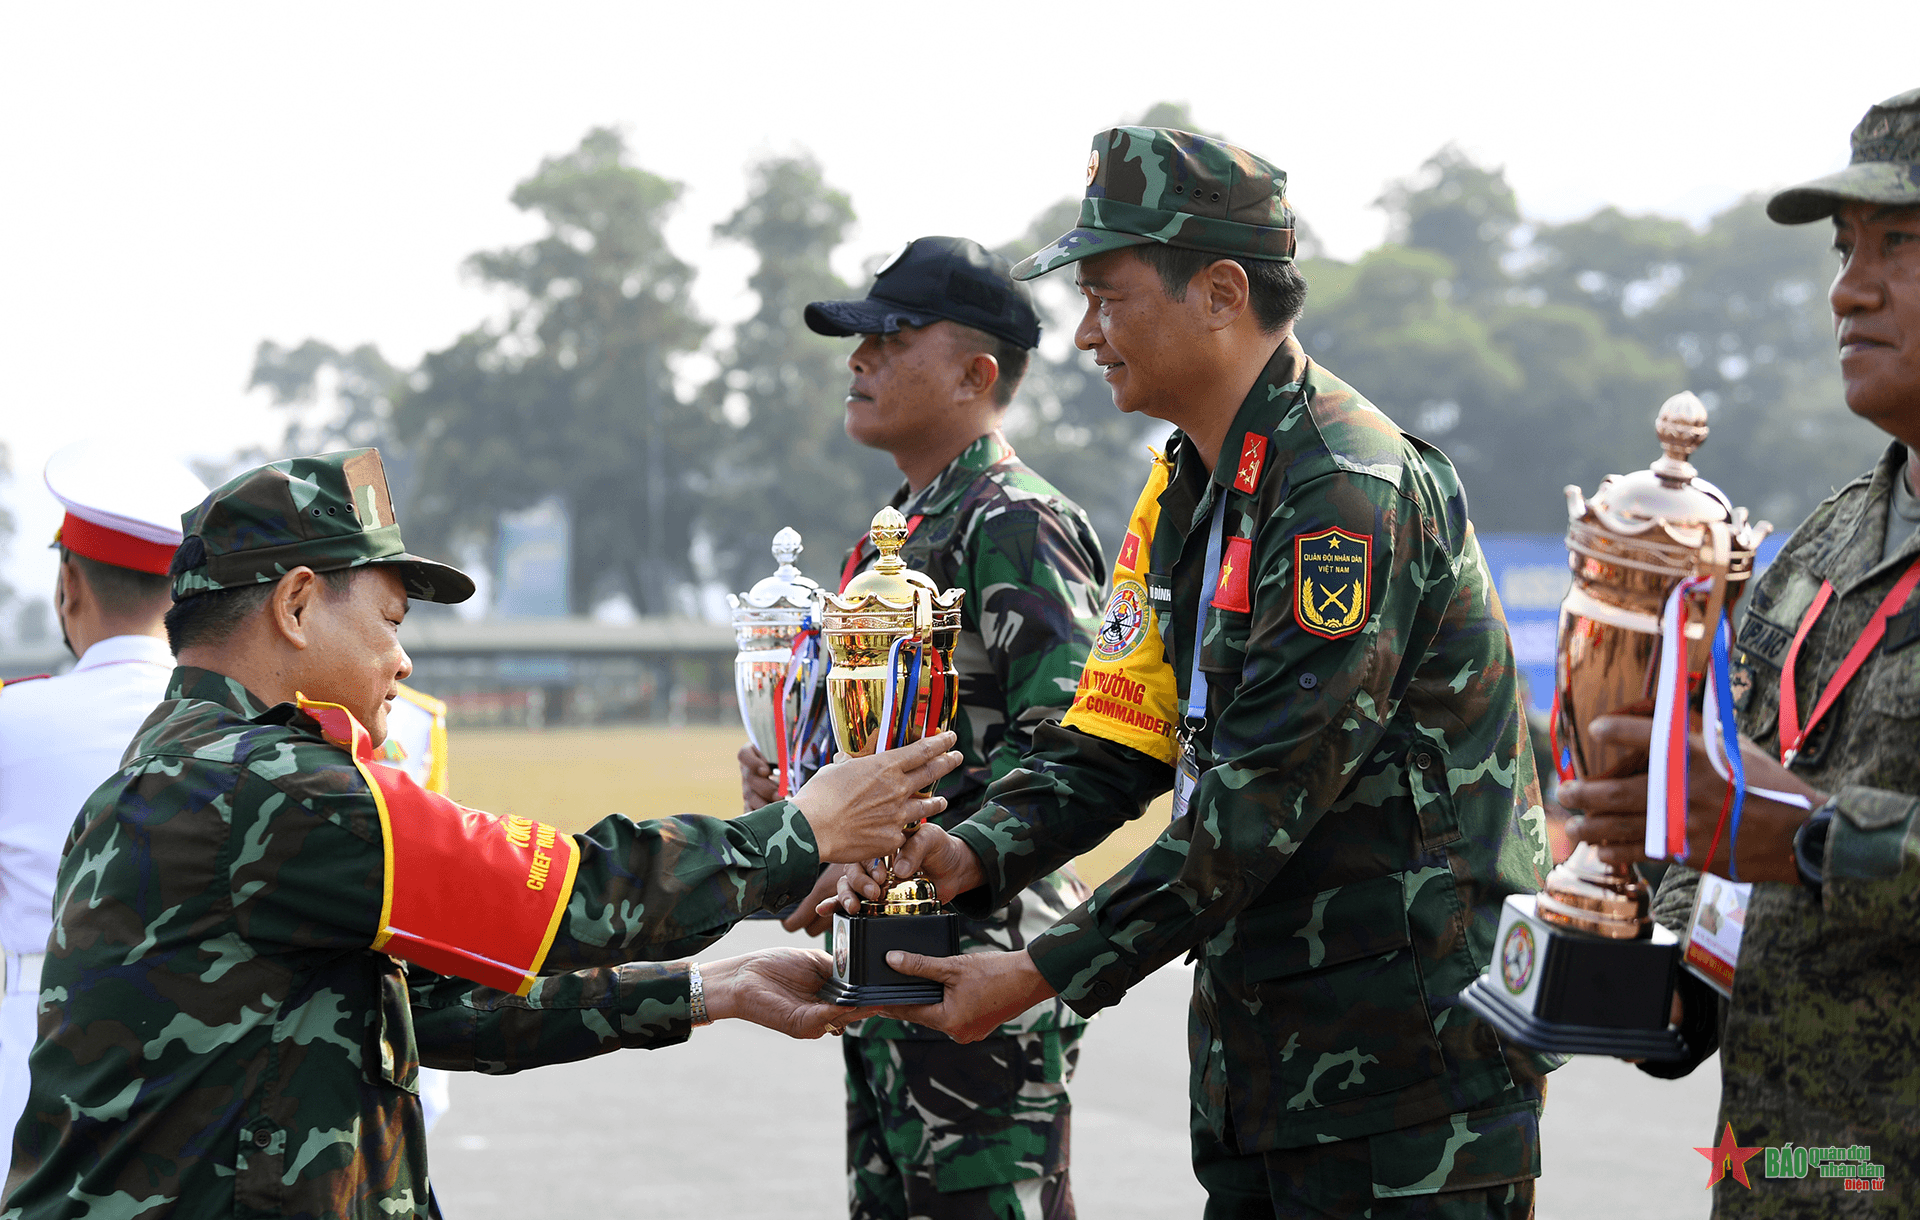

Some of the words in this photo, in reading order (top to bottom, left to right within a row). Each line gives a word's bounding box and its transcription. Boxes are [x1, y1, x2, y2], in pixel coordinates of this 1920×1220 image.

[1303, 552, 1322, 562] QUÂN
[1317, 564, 1334, 575] VIỆT
[1086, 695, 1172, 738] COMMANDER
[526, 849, 552, 891] CHIEF
